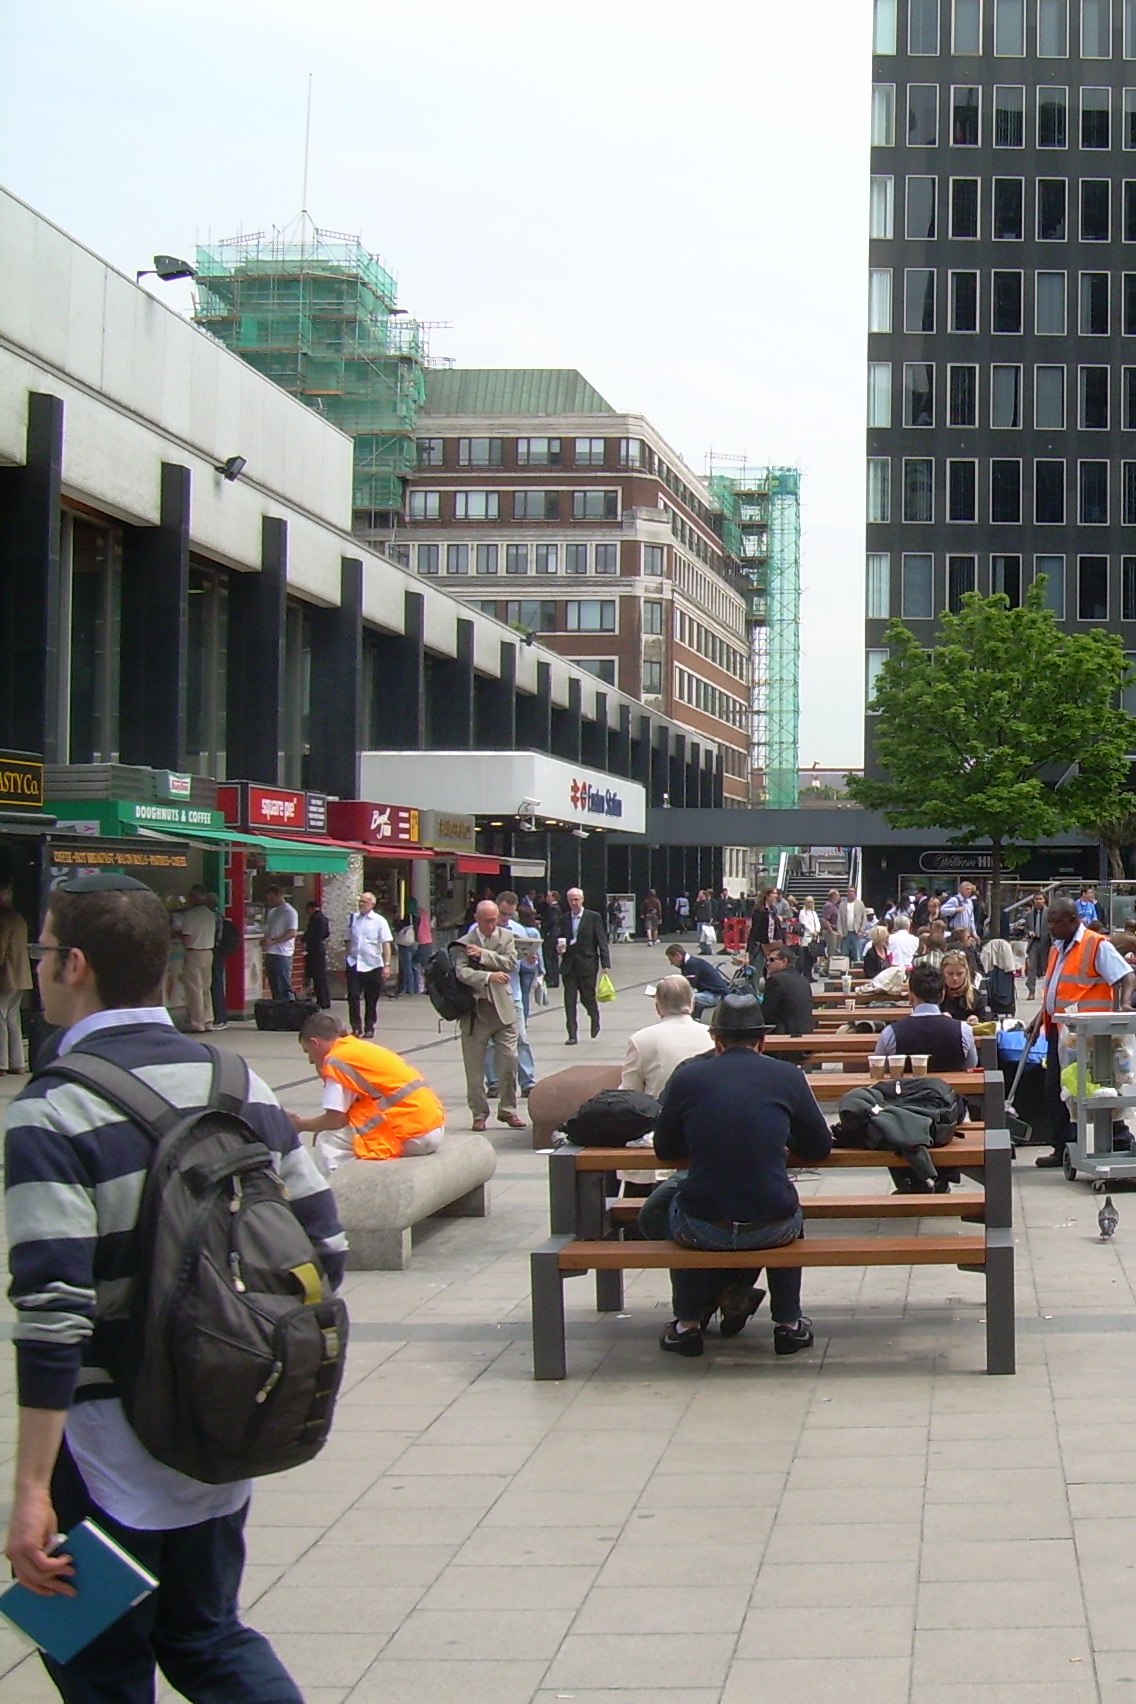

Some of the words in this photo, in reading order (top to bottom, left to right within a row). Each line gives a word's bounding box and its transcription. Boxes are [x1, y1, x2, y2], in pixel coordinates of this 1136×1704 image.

[135, 805, 180, 821] DOUGHNUTS
[181, 810, 187, 822] &
[188, 810, 212, 825] COFFEE
